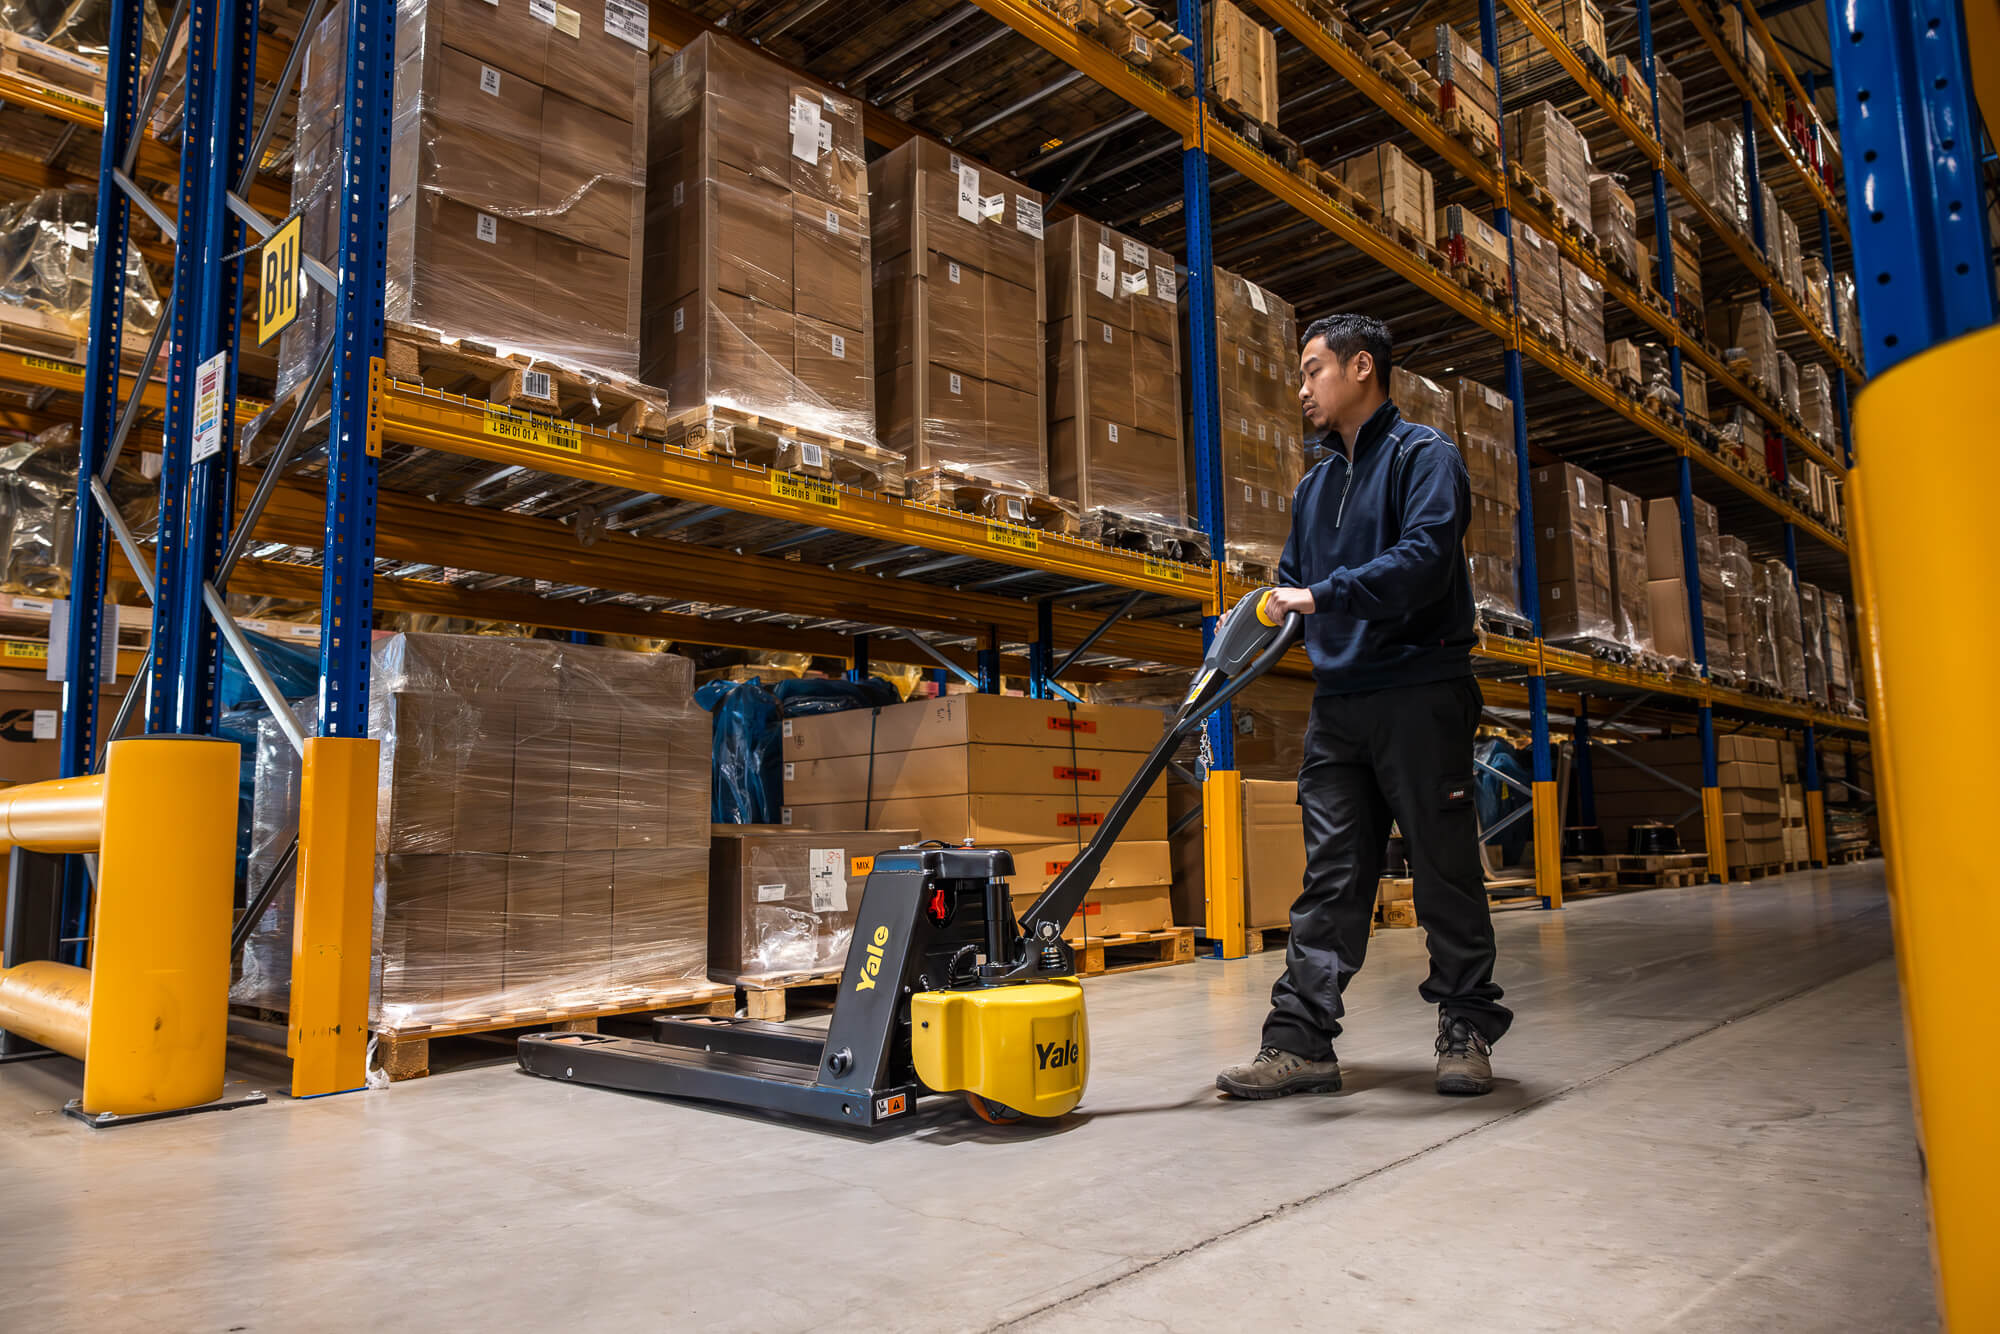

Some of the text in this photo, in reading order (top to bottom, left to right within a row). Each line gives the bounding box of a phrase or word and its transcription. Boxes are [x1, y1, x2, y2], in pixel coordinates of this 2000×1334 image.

[264, 235, 294, 327] BH
[499, 423, 538, 441] BH 01 01 A
[531, 418, 542, 430] BH
[782, 486, 810, 500] BH 01 01 B
[856, 861, 870, 870] MIX
[855, 925, 889, 992] Yale
[1036, 1039, 1079, 1070] Yale
